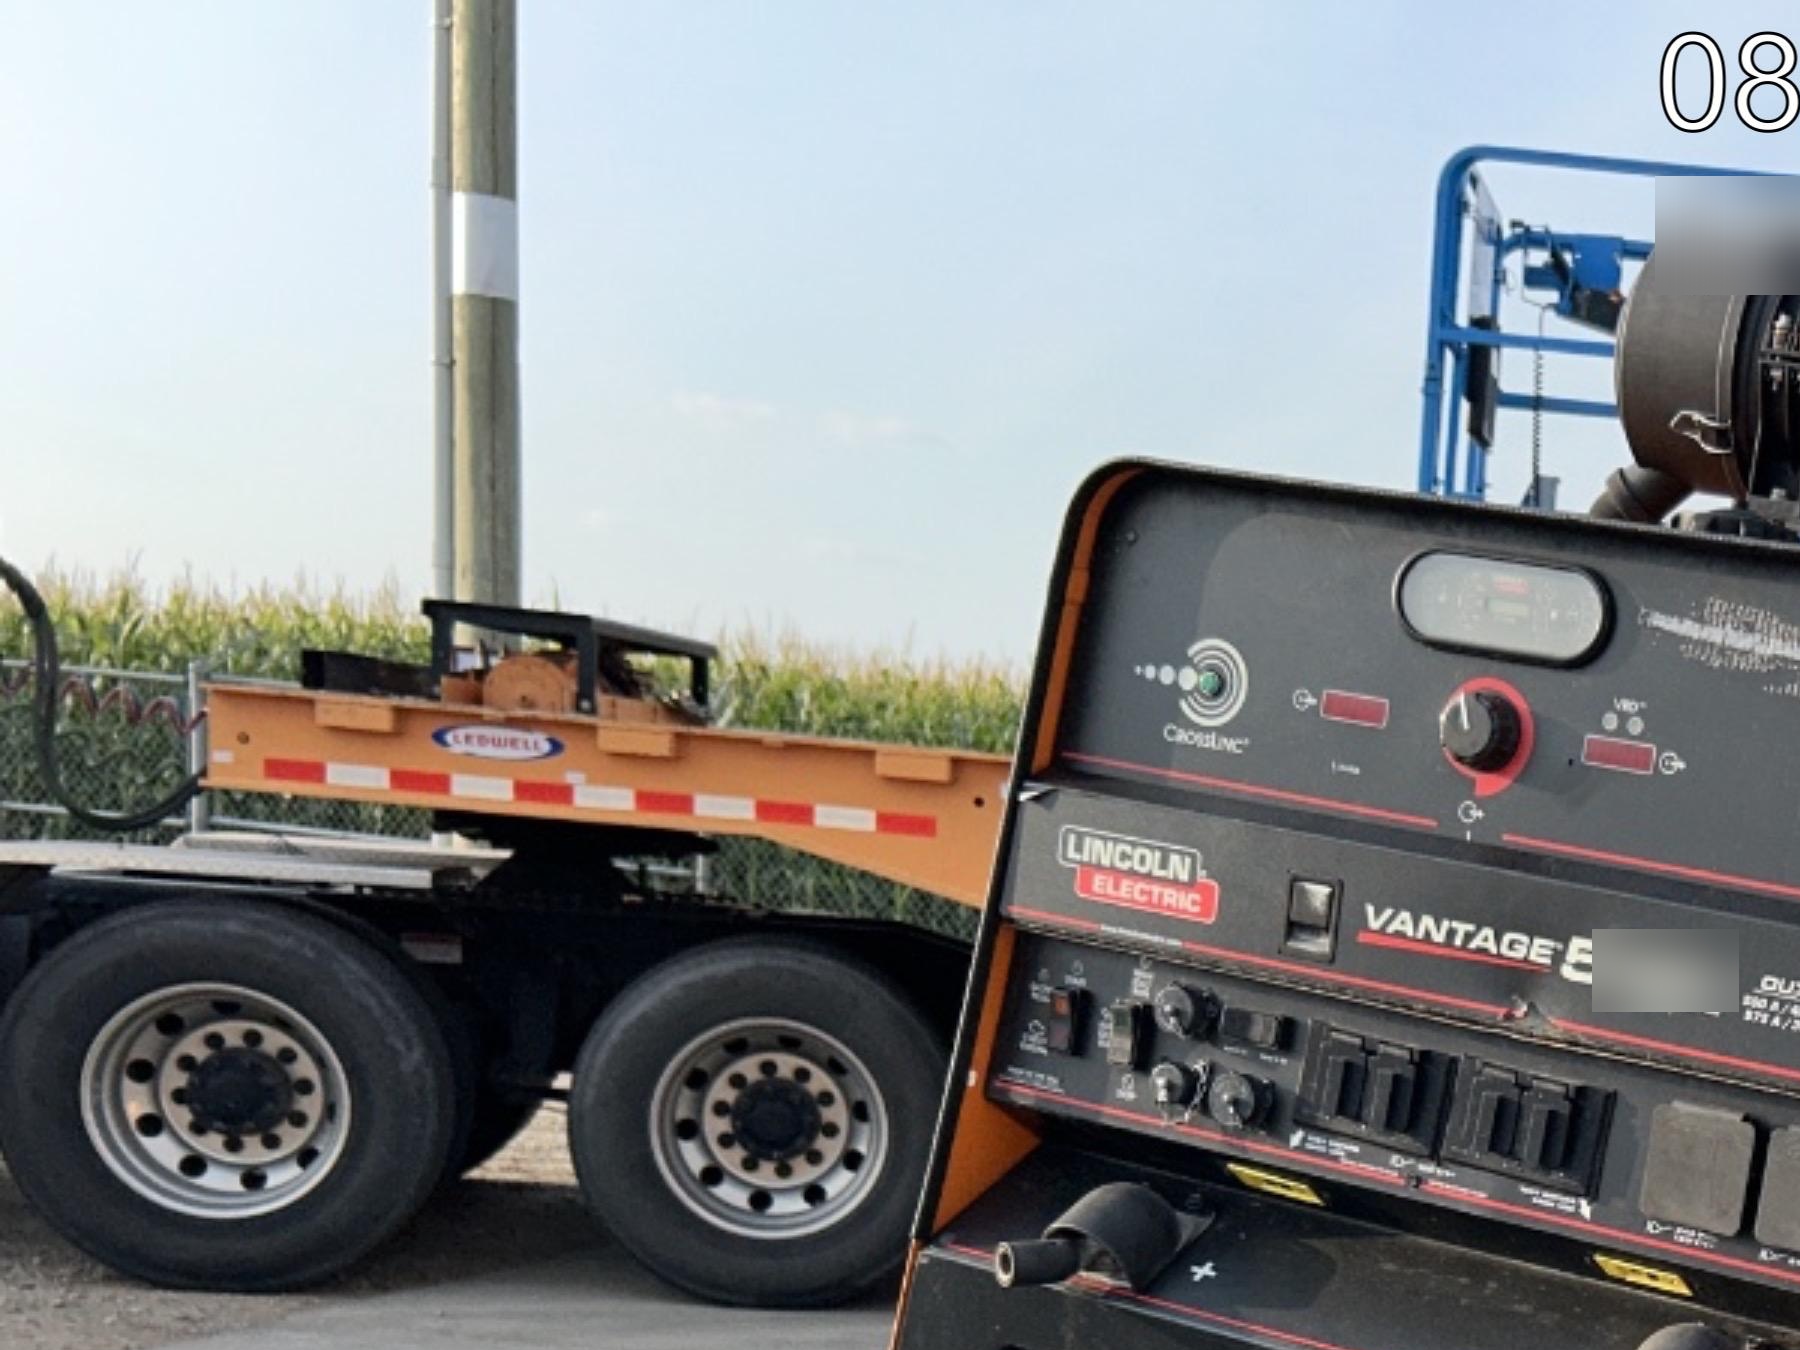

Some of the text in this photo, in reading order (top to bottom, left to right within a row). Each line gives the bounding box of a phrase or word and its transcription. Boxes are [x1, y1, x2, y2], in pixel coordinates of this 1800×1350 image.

[1067, 832, 1192, 883] LINCOLN
[1092, 873, 1201, 913] ELECTRIC
[1364, 902, 1556, 965] VANTAGE
